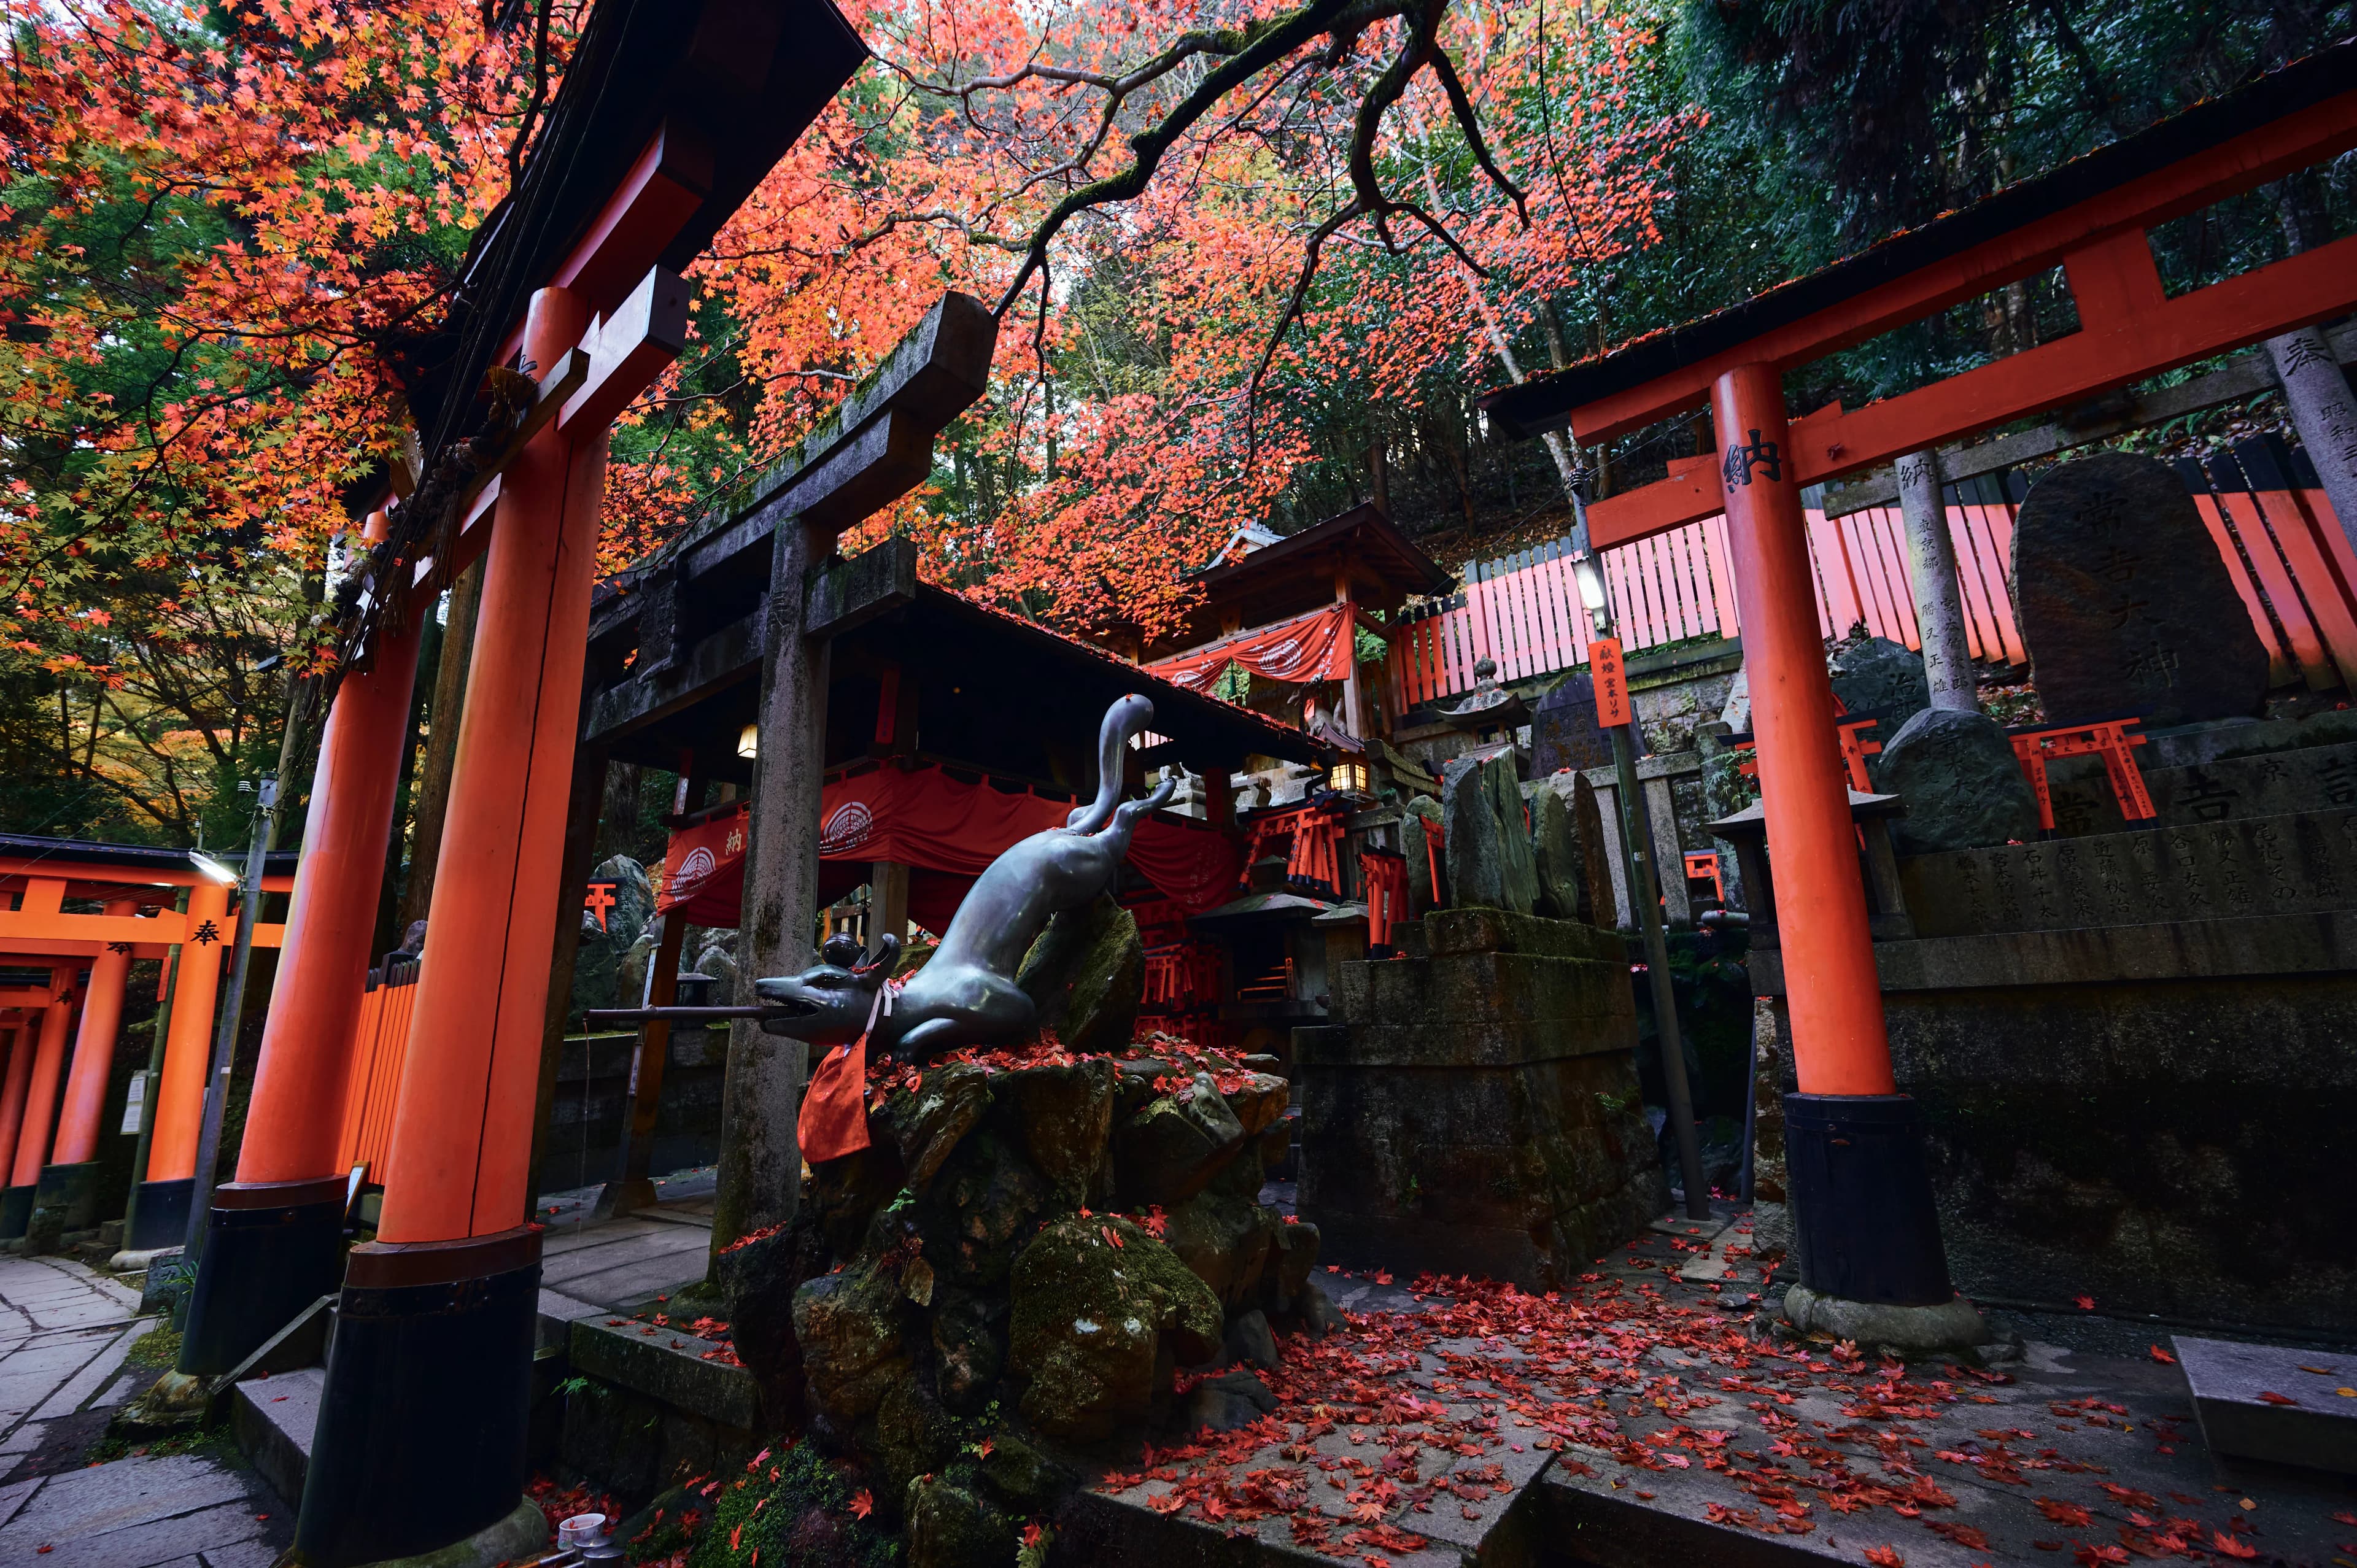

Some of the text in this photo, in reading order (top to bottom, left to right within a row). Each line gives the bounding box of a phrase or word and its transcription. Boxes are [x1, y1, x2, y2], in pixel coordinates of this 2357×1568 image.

[1723, 429, 1781, 493] 納
[1900, 459, 1934, 491] 納
[1918, 519, 1939, 570] 東京都
[725, 828, 742, 856] 納
[190, 919, 220, 947] 奉
